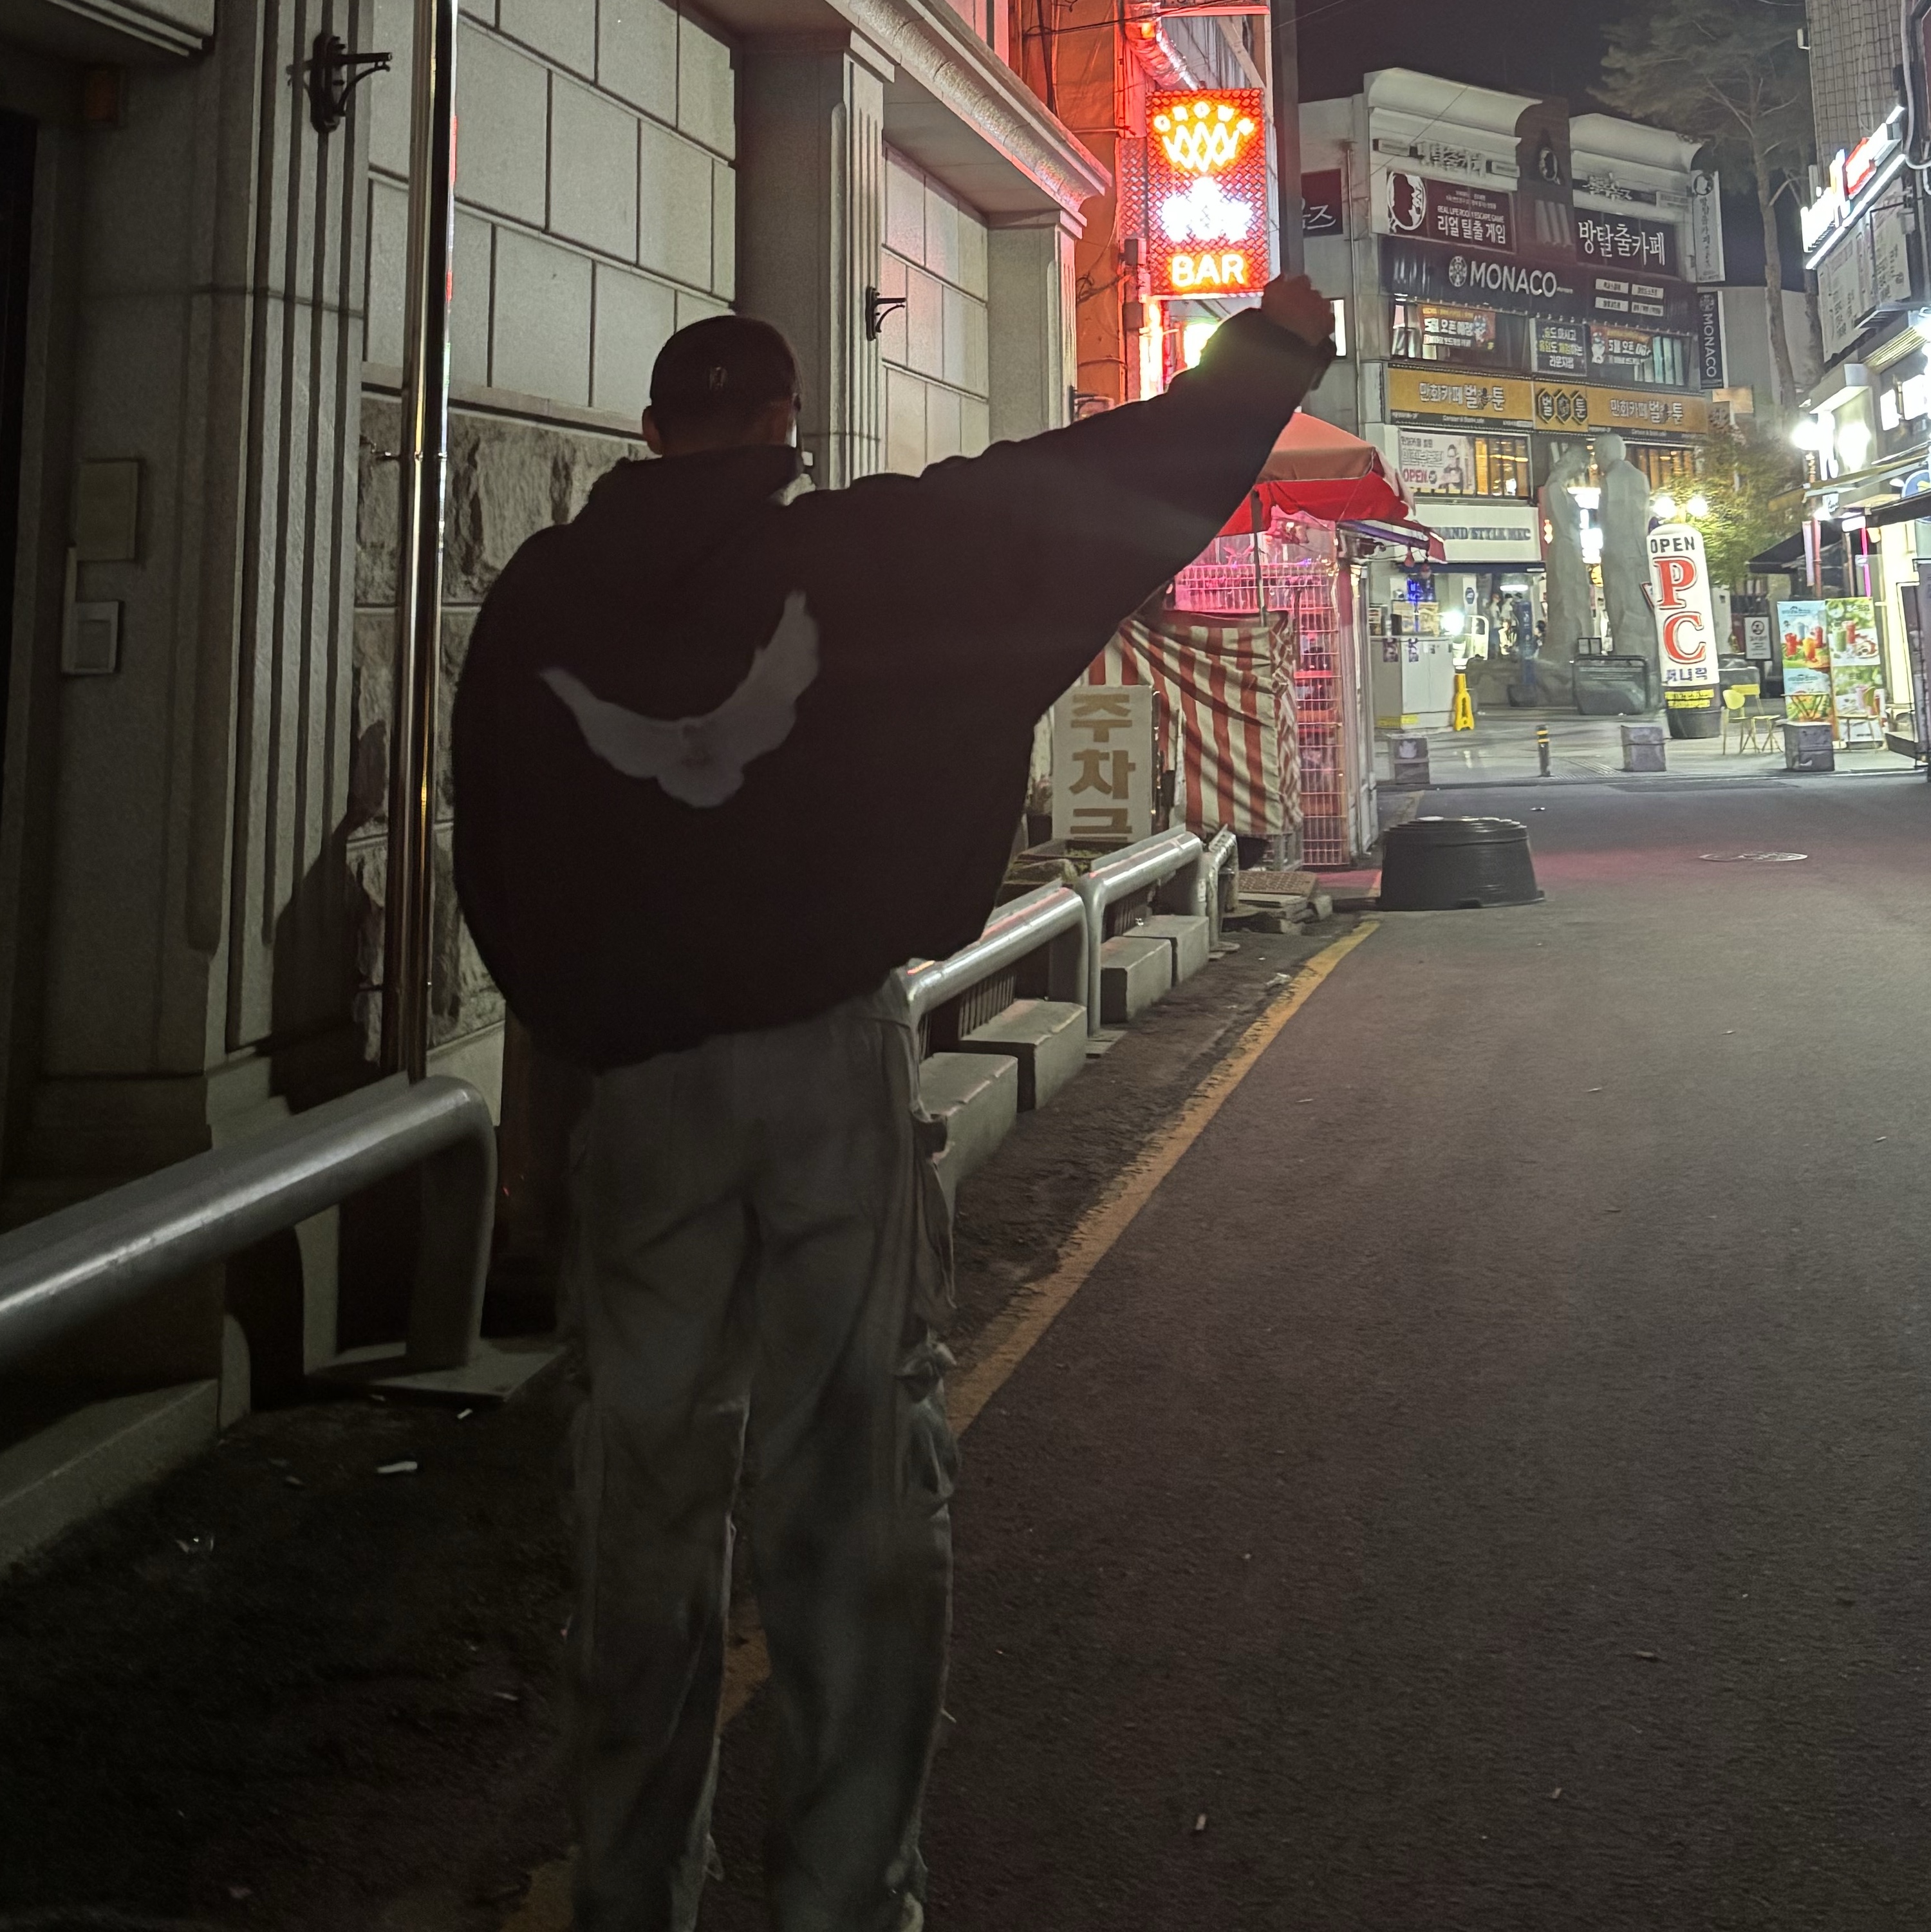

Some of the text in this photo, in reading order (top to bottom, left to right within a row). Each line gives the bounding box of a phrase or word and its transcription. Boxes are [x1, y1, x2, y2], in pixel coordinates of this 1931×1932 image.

[1437, 215, 1459, 238] 리얼
[1486, 223, 1506, 244] 게임
[1578, 220, 1665, 266] 방탈출카페
[1171, 254, 1245, 287] BAR
[1470, 260, 1557, 297] MONACO
[1703, 313, 1717, 379] MONACO
[1419, 383, 1463, 406] 만화카페
[1650, 536, 1695, 554] OPEN
